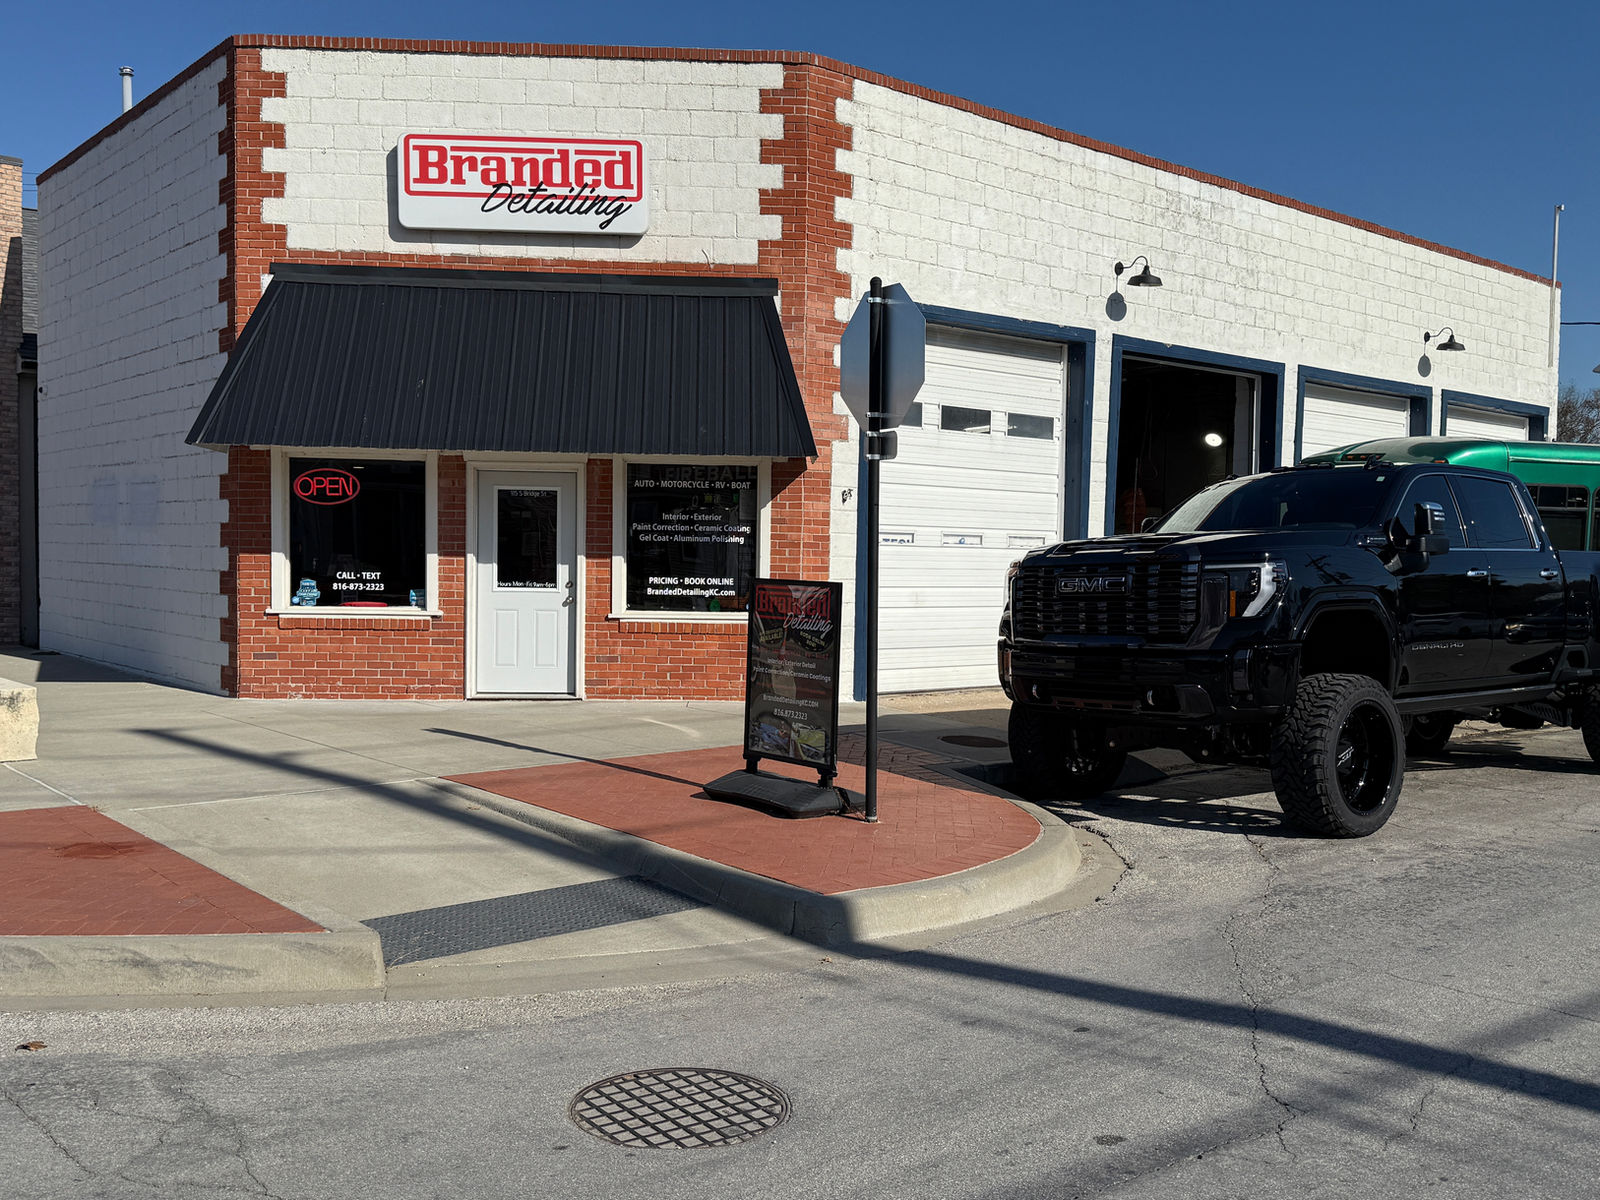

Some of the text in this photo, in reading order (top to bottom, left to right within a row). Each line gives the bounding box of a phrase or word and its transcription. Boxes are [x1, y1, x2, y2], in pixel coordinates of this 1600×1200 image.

[412, 145, 634, 189] Branded
[480, 181, 633, 229] Detailing
[296, 476, 353, 496] OPEN
[634, 480, 751, 489] AUTO MOTORCYCLE RV BOAT
[662, 512, 722, 521] Interior Exterior
[632, 523, 752, 534] Paint Correction Ceramic Coating
[639, 533, 652, 541] Gel
[673, 534, 710, 542] Aluminum
[711, 535, 745, 544] Polishing
[336, 571, 381, 580] CALL TEXT
[648, 576, 734, 586] PRICING BOOK ONLINE
[332, 583, 384, 591] 816-873-2323
[1058, 577, 1125, 592] GMC
[647, 587, 736, 597] BrandedDetailingKC.com
[783, 612, 834, 639] Detailing
[809, 673, 831, 683] Coatings
[773, 708, 808, 720] 816.873.2323
